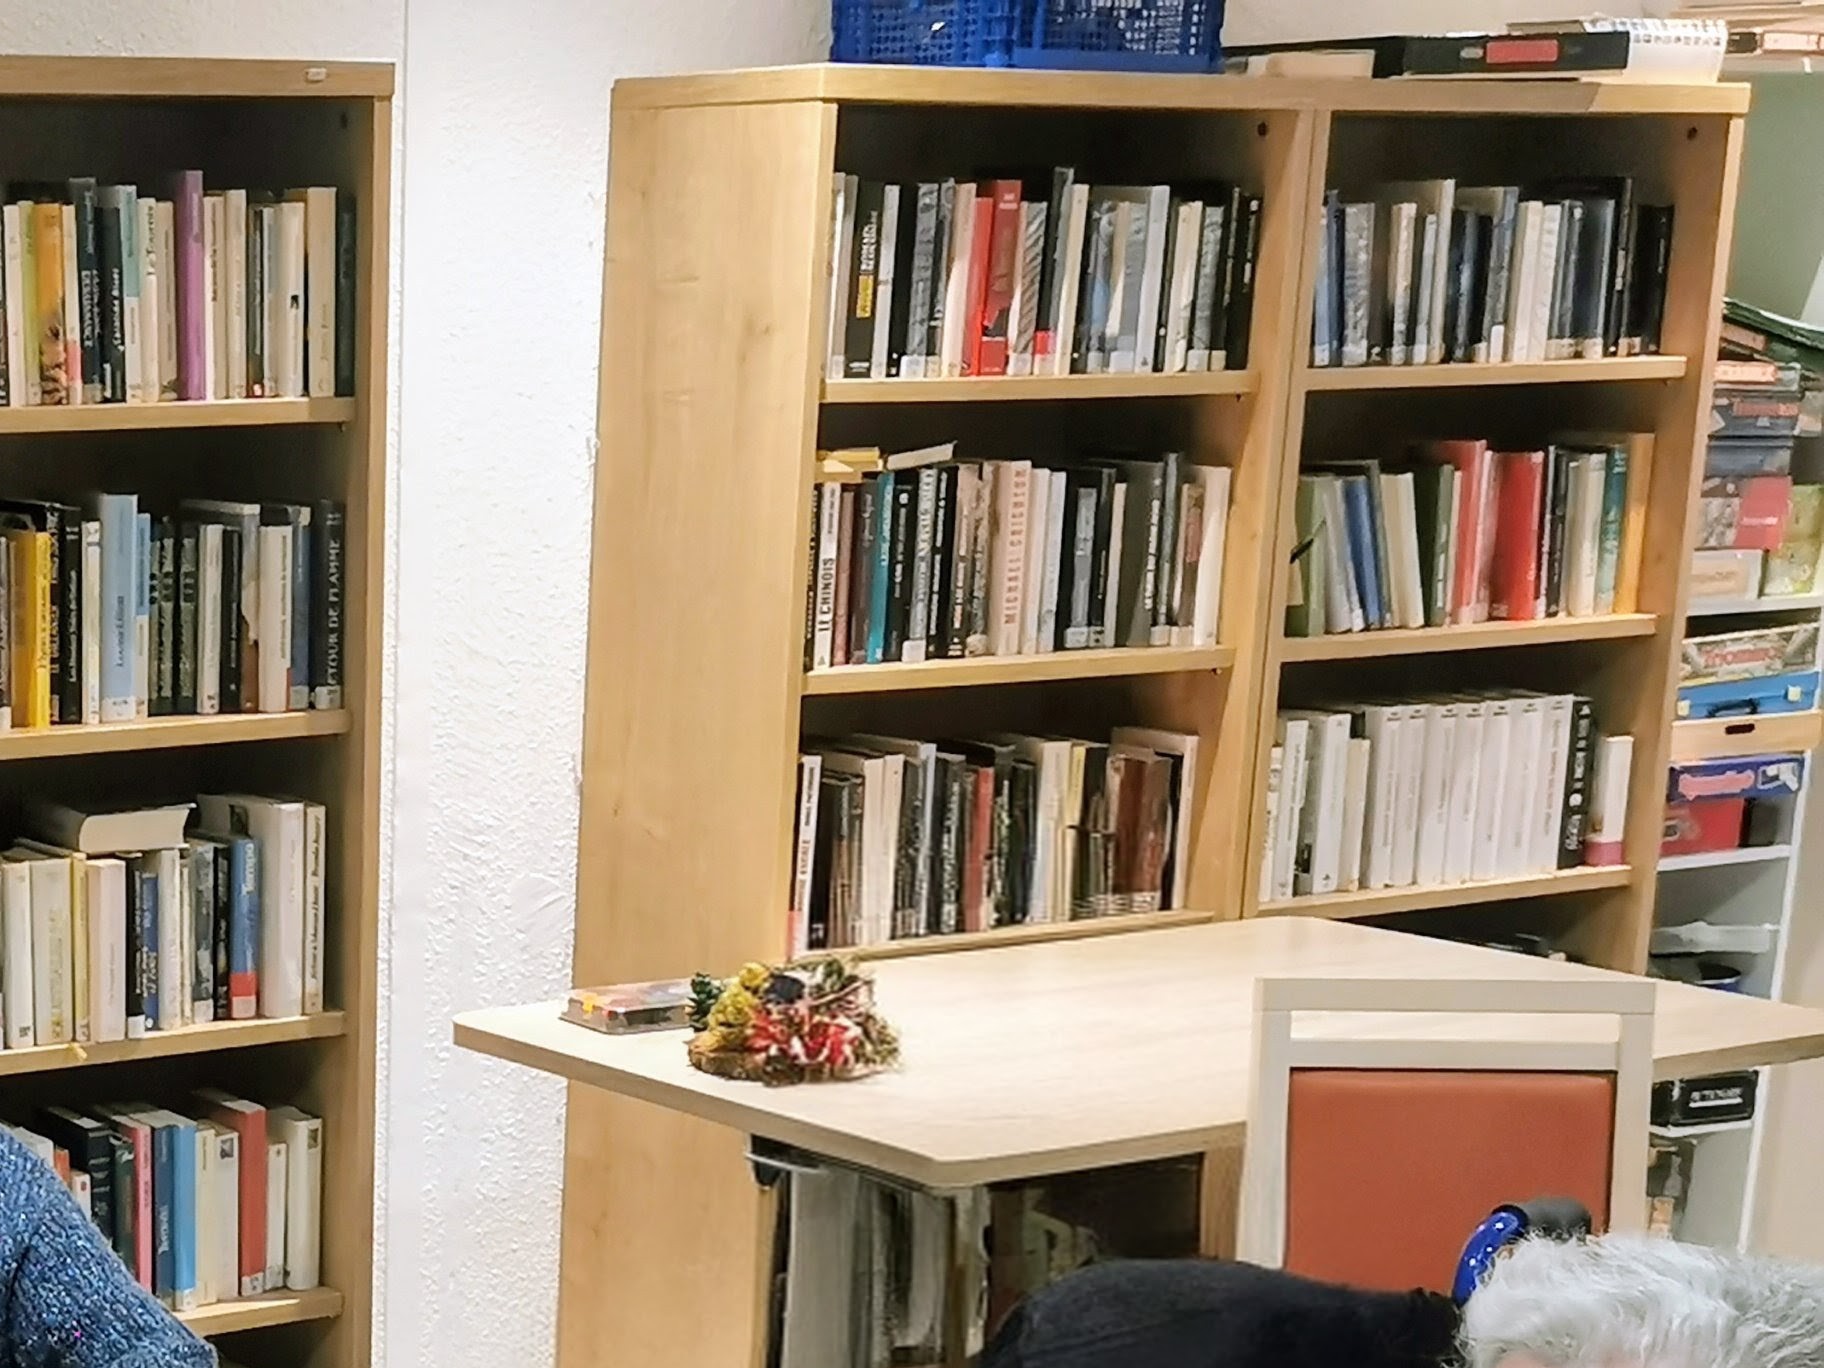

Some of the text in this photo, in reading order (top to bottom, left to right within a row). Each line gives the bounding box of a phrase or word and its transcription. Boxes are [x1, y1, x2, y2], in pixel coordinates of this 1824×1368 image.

[326, 539, 341, 602] FLAMME
[821, 558, 833, 615] CHINOIS
[327, 607, 340, 627] DE
